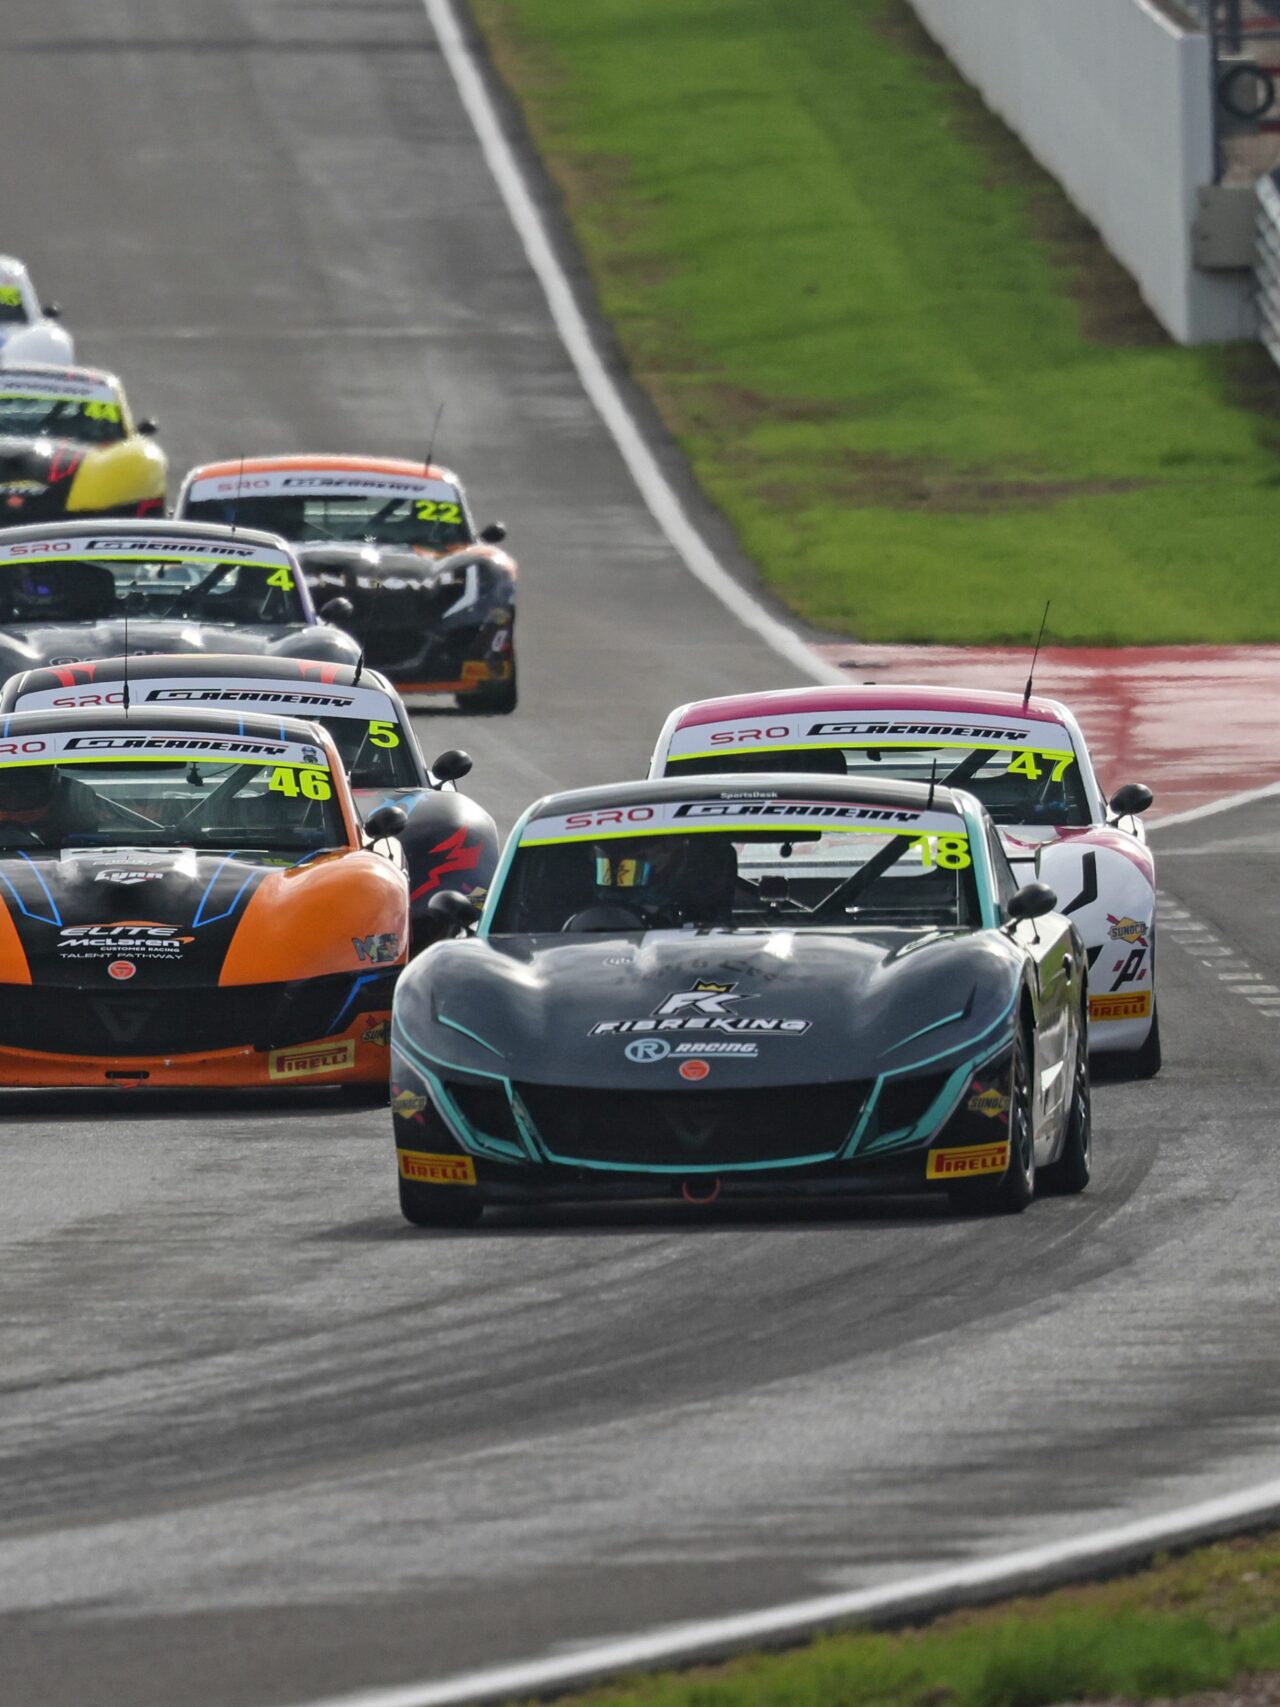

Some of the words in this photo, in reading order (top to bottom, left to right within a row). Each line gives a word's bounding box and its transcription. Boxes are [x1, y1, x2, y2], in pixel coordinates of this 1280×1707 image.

[414, 500, 463, 525] 22
[9, 542, 71, 557] SRO
[266, 568, 295, 593] 4
[368, 719, 401, 749] 5
[710, 726, 790, 746] SRO
[1007, 751, 1075, 783] 47
[268, 766, 332, 801] 46
[719, 791, 779, 800] SportsDesk
[564, 806, 655, 831] SRO
[908, 836, 972, 871] 18
[57, 938, 181, 948] McLaren
[59, 926, 179, 937] ELITE
[1110, 923, 1147, 939] SUNOCO
[590, 1016, 810, 1035] FIBREKING
[275, 1045, 349, 1074] PIRELLI
[401, 1154, 469, 1181] PIRELLI
[934, 1145, 1008, 1174] PIRELLI
